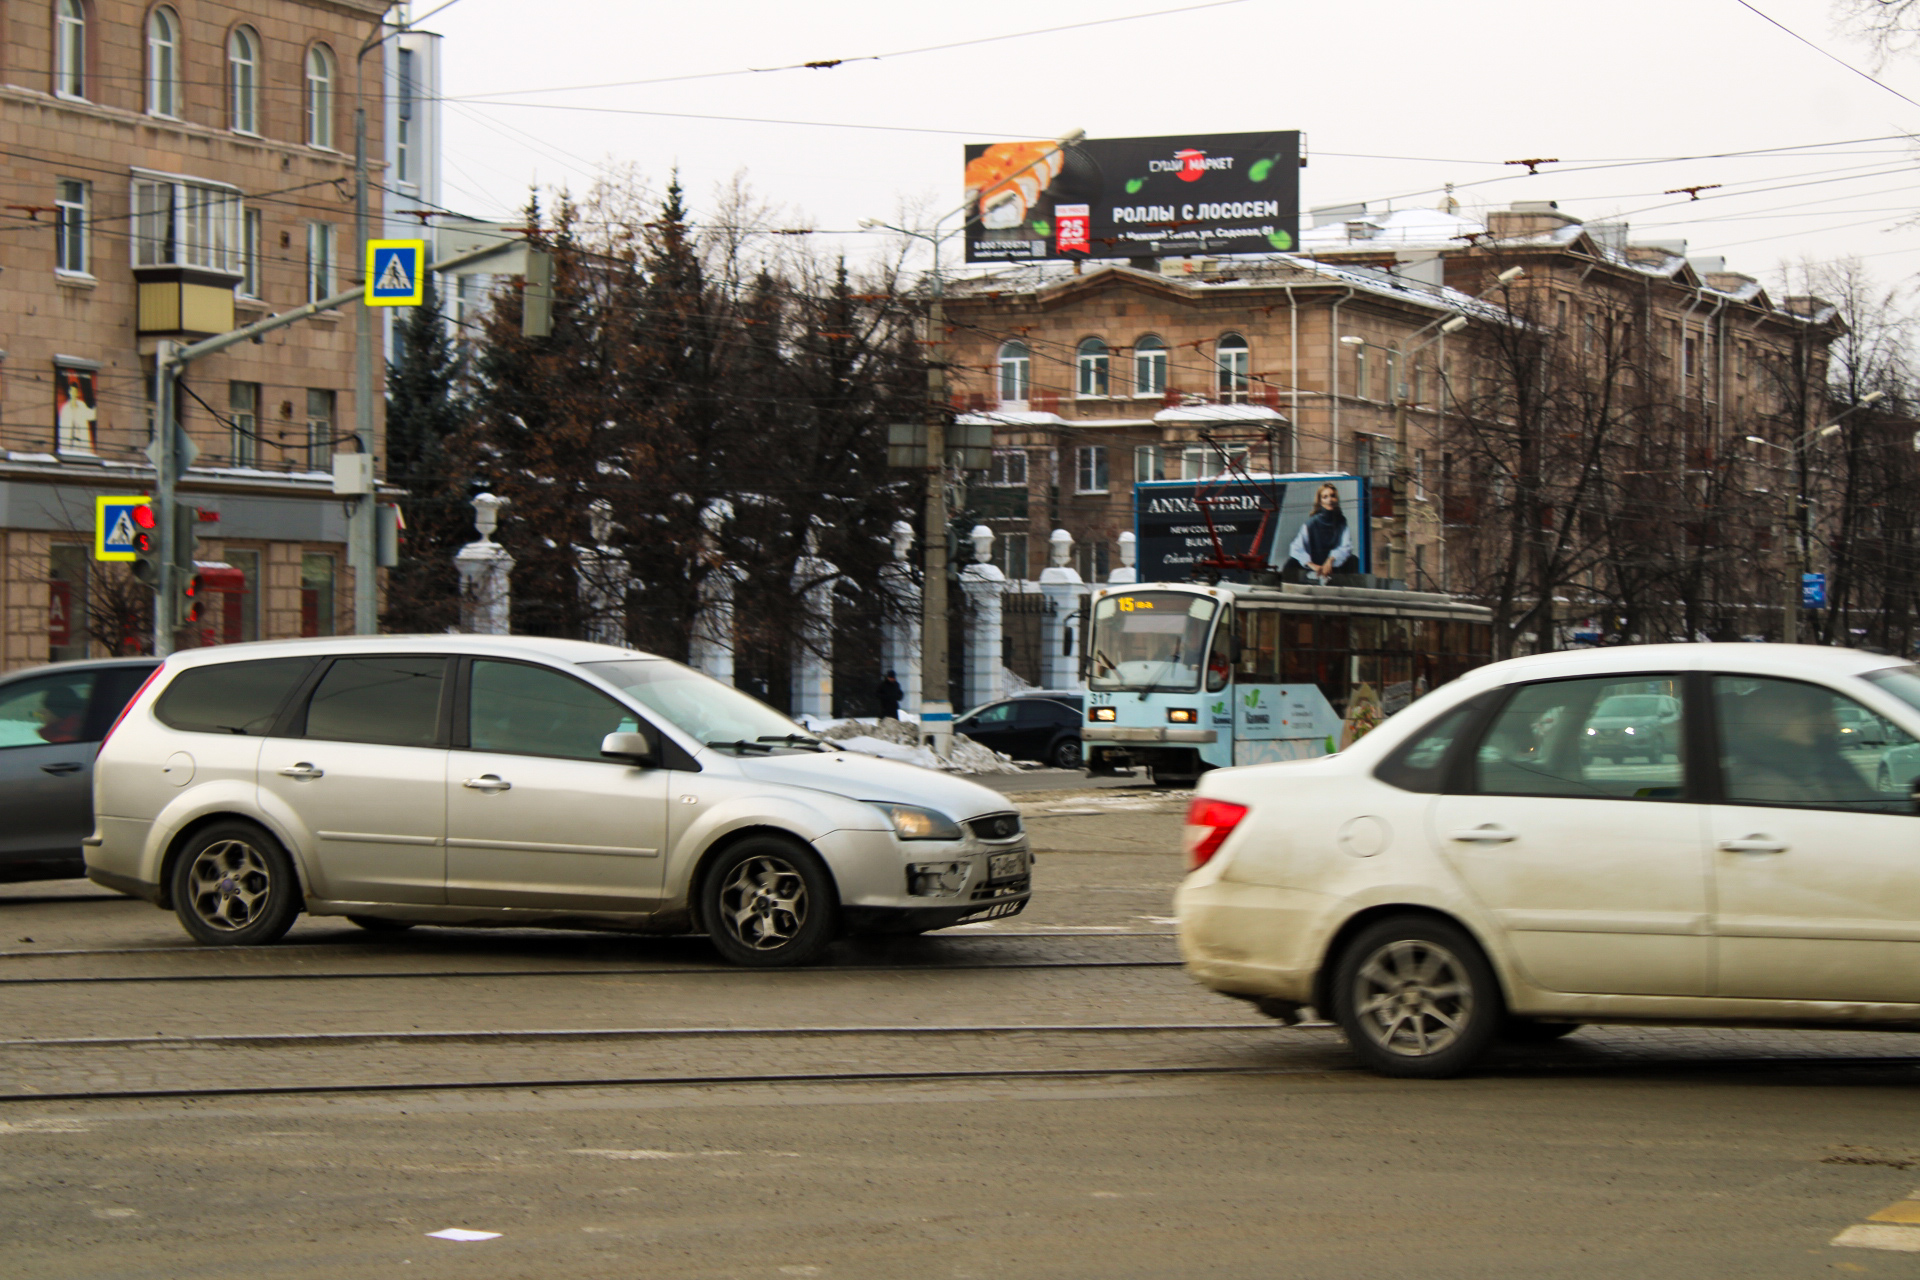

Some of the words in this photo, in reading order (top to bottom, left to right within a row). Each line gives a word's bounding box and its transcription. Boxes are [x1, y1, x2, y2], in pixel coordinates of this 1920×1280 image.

[1188, 157, 1234, 171] МАРКЕТ
[1112, 205, 1175, 224] РОЛЛЫ
[1181, 203, 1194, 221] С
[1196, 200, 1279, 220] ЛОСОСЕМ
[1060, 219, 1084, 238] 25
[1147, 497, 1201, 514] ANNA
[1206, 495, 1262, 512] VERDI
[1169, 526, 1190, 534] NEW
[1189, 524, 1238, 534] COLLCTION
[1185, 537, 1223, 547] BULMR
[1119, 597, 1134, 612] 15
[1091, 692, 1112, 704] 317
